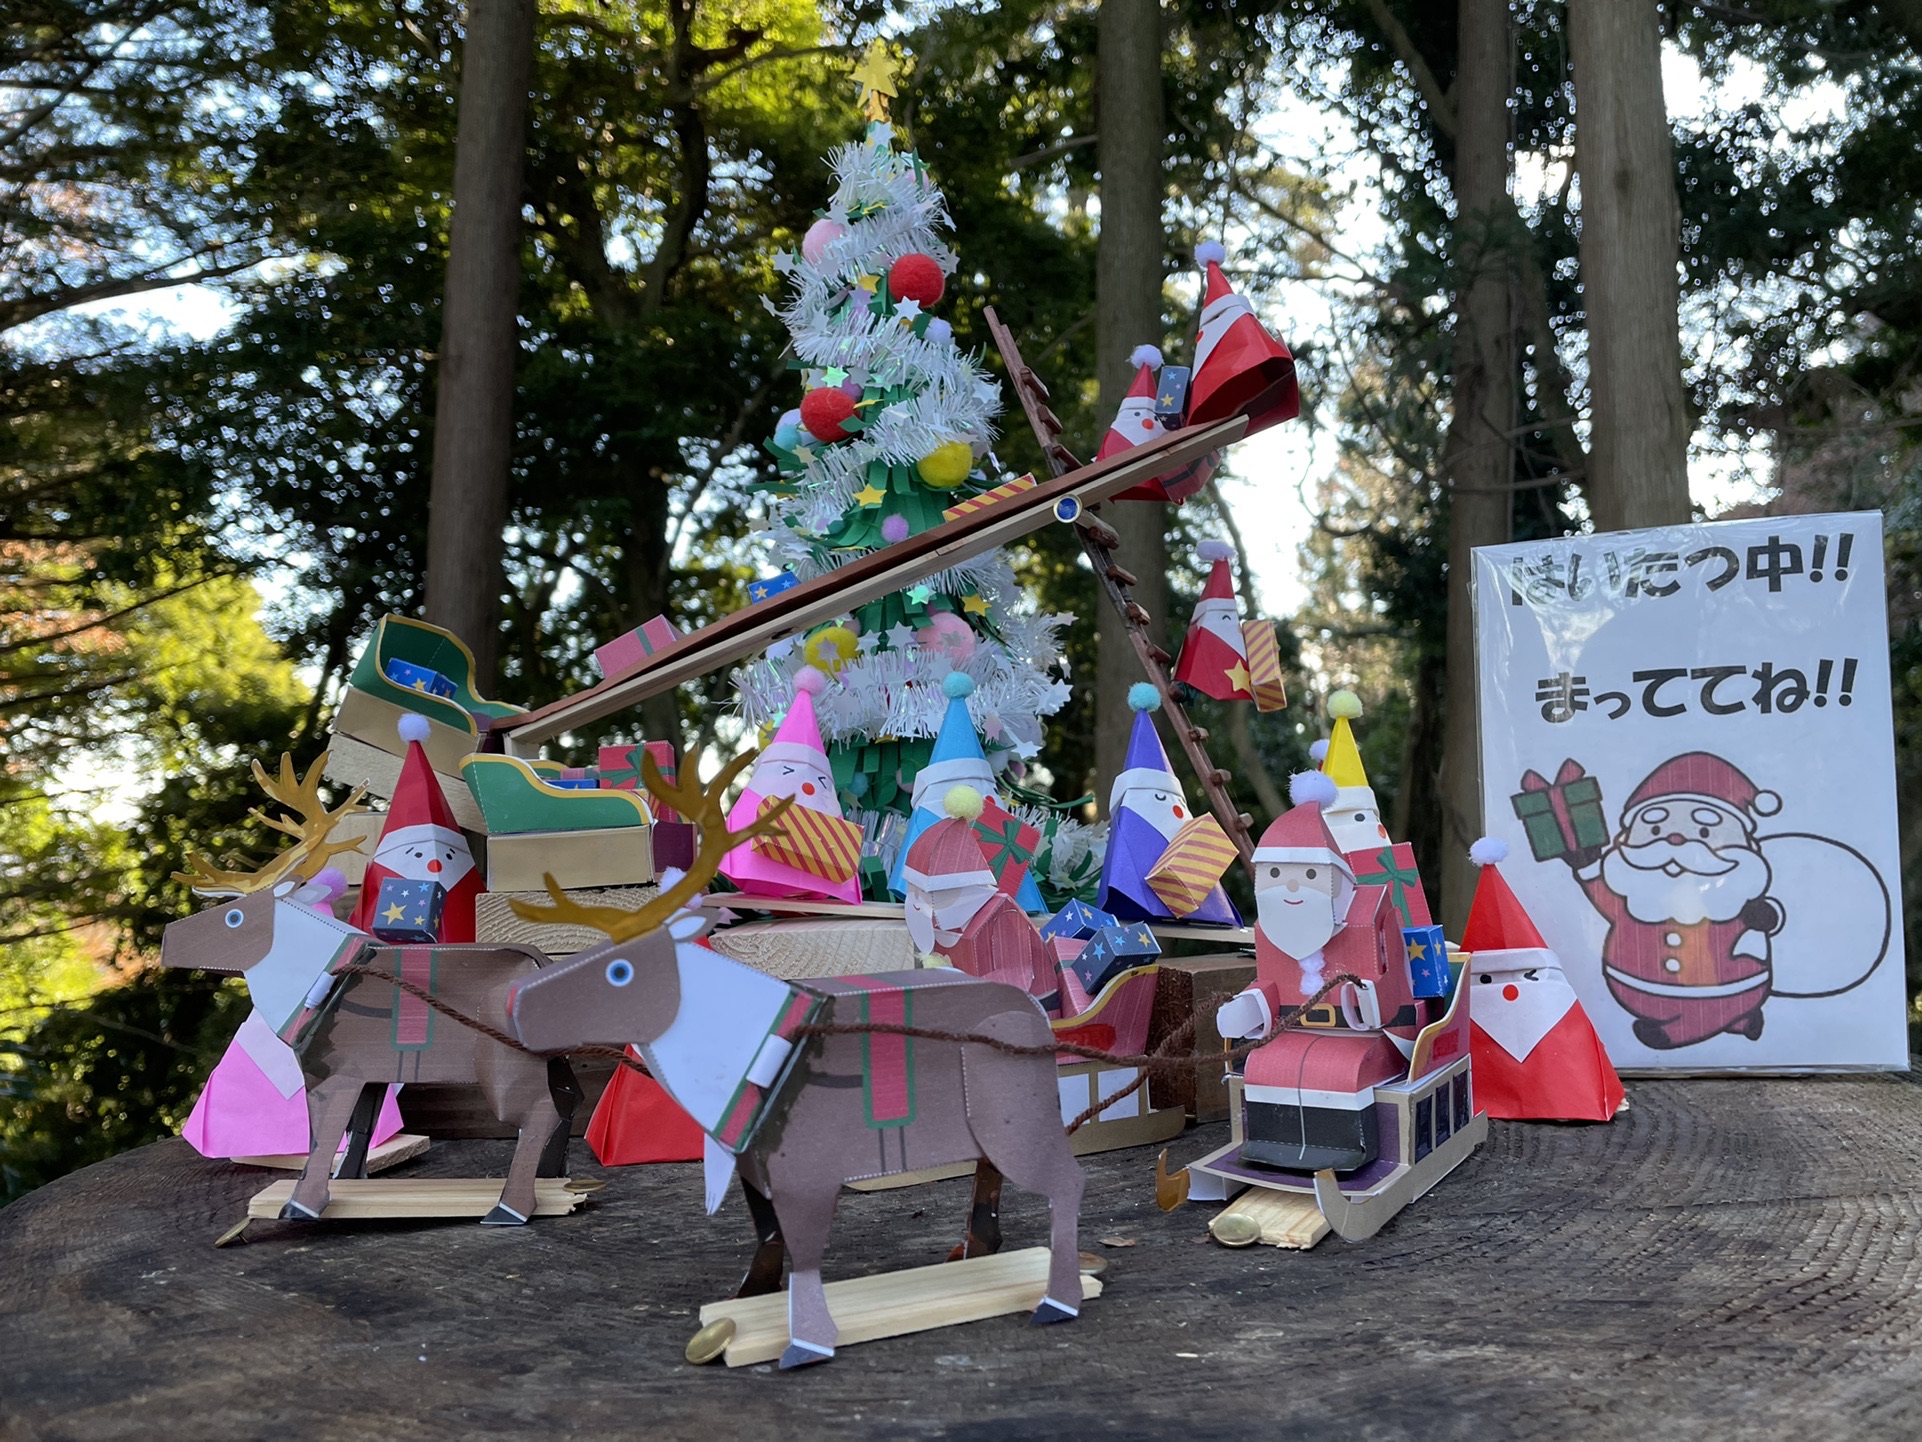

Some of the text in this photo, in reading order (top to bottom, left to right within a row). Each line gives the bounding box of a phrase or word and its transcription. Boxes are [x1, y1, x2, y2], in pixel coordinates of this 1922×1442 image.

[1512, 533, 1854, 605] はいたつ中!!
[1535, 658, 1858, 723] まっててね!!
